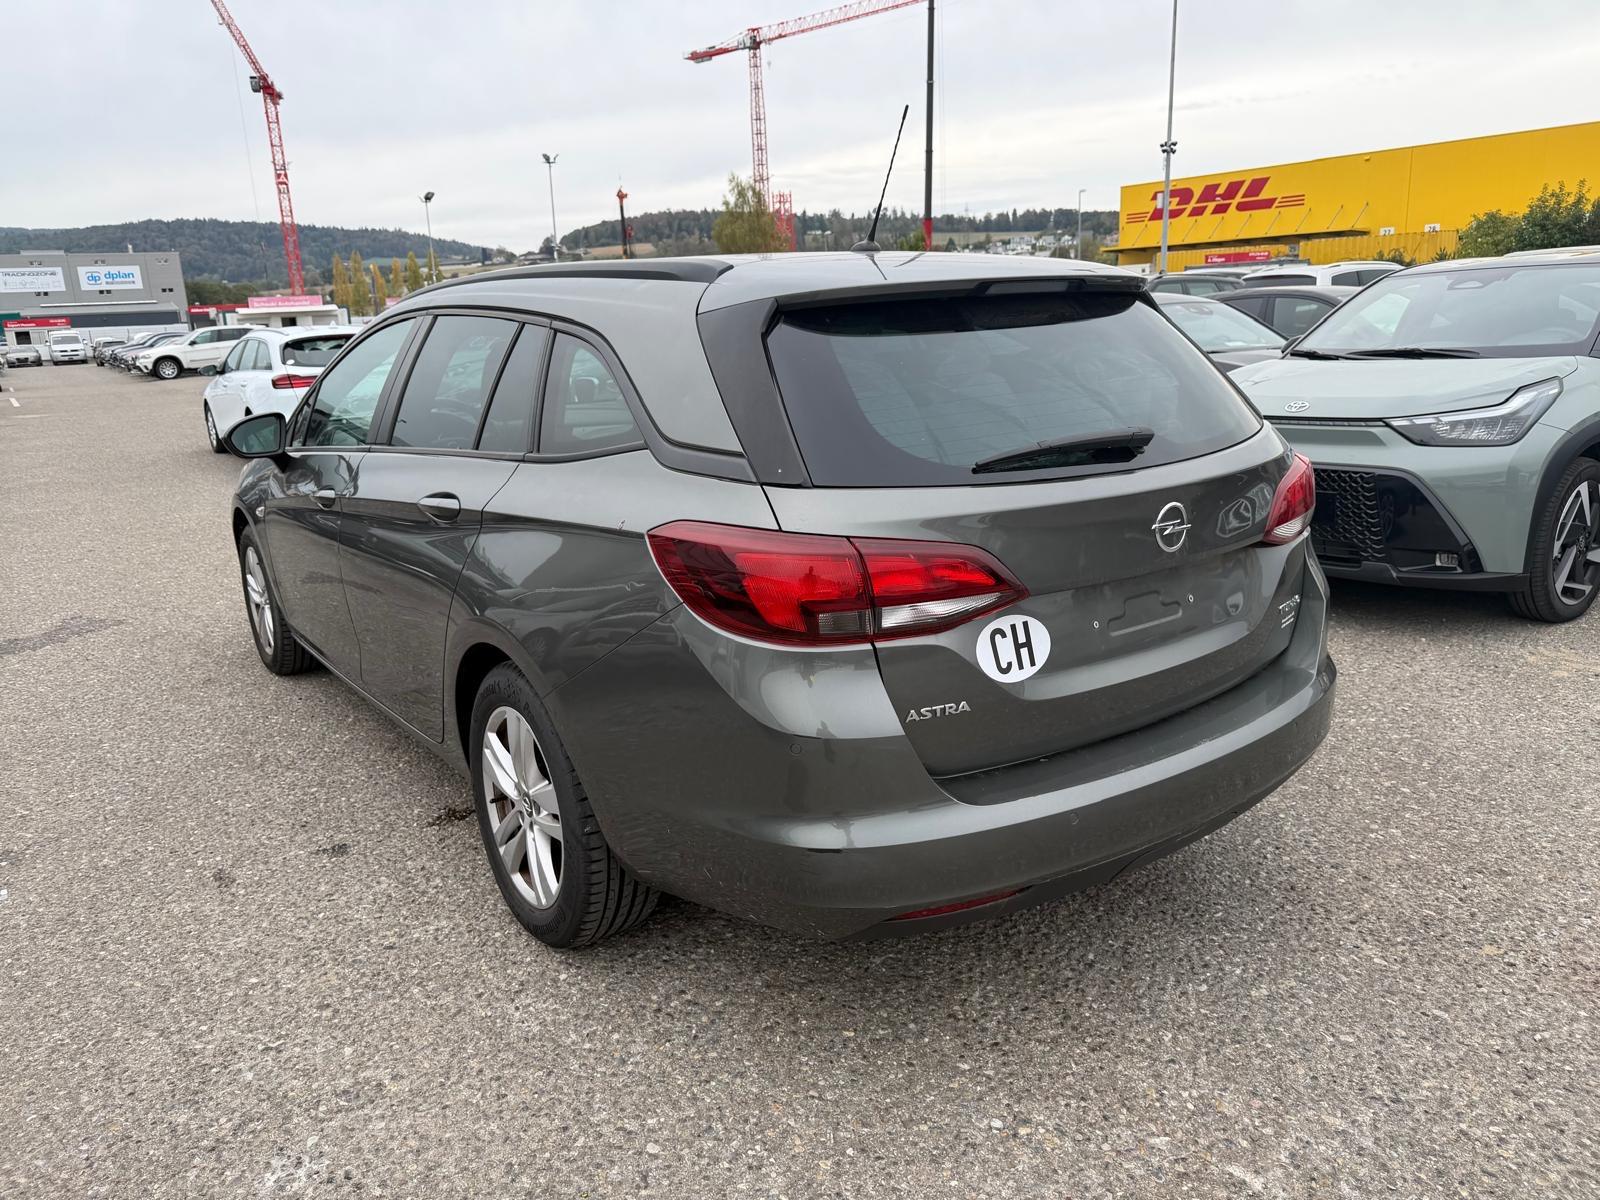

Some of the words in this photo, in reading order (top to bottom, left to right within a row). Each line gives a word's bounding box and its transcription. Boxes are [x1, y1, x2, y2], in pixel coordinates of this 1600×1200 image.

[1148, 176, 1278, 222] DHL
[104, 271, 135, 280] dplan
[989, 620, 1037, 675] CH
[905, 700, 971, 723] ASTRA
